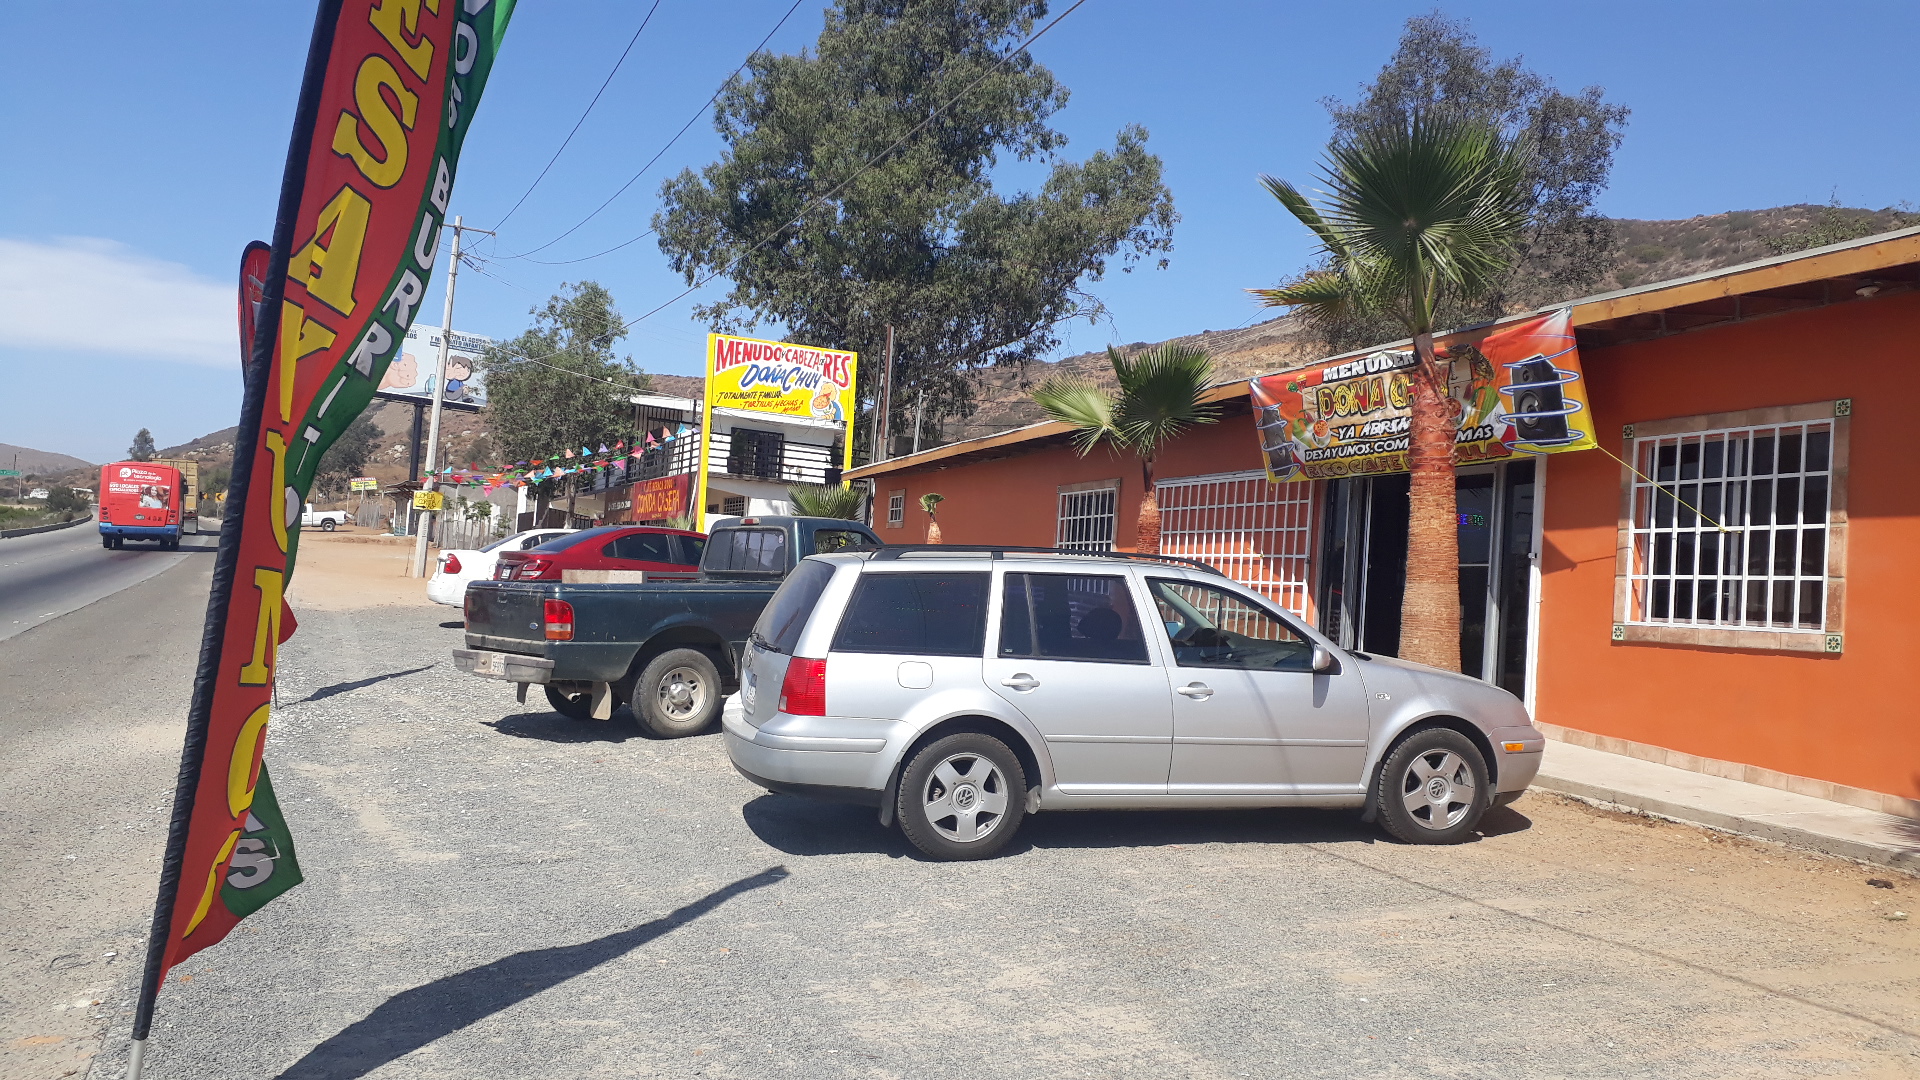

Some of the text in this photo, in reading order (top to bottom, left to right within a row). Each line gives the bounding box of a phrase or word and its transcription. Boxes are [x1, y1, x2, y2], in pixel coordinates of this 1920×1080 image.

[715, 339, 782, 373] MENUDO
[785, 348, 819, 372] CABEZA
[823, 353, 851, 388] RES
[740, 363, 823, 392] DOÑA CHUY
[1338, 424, 1356, 440] YA
[1304, 462, 1349, 478] RICO
[1349, 454, 1404, 473] CAFE
